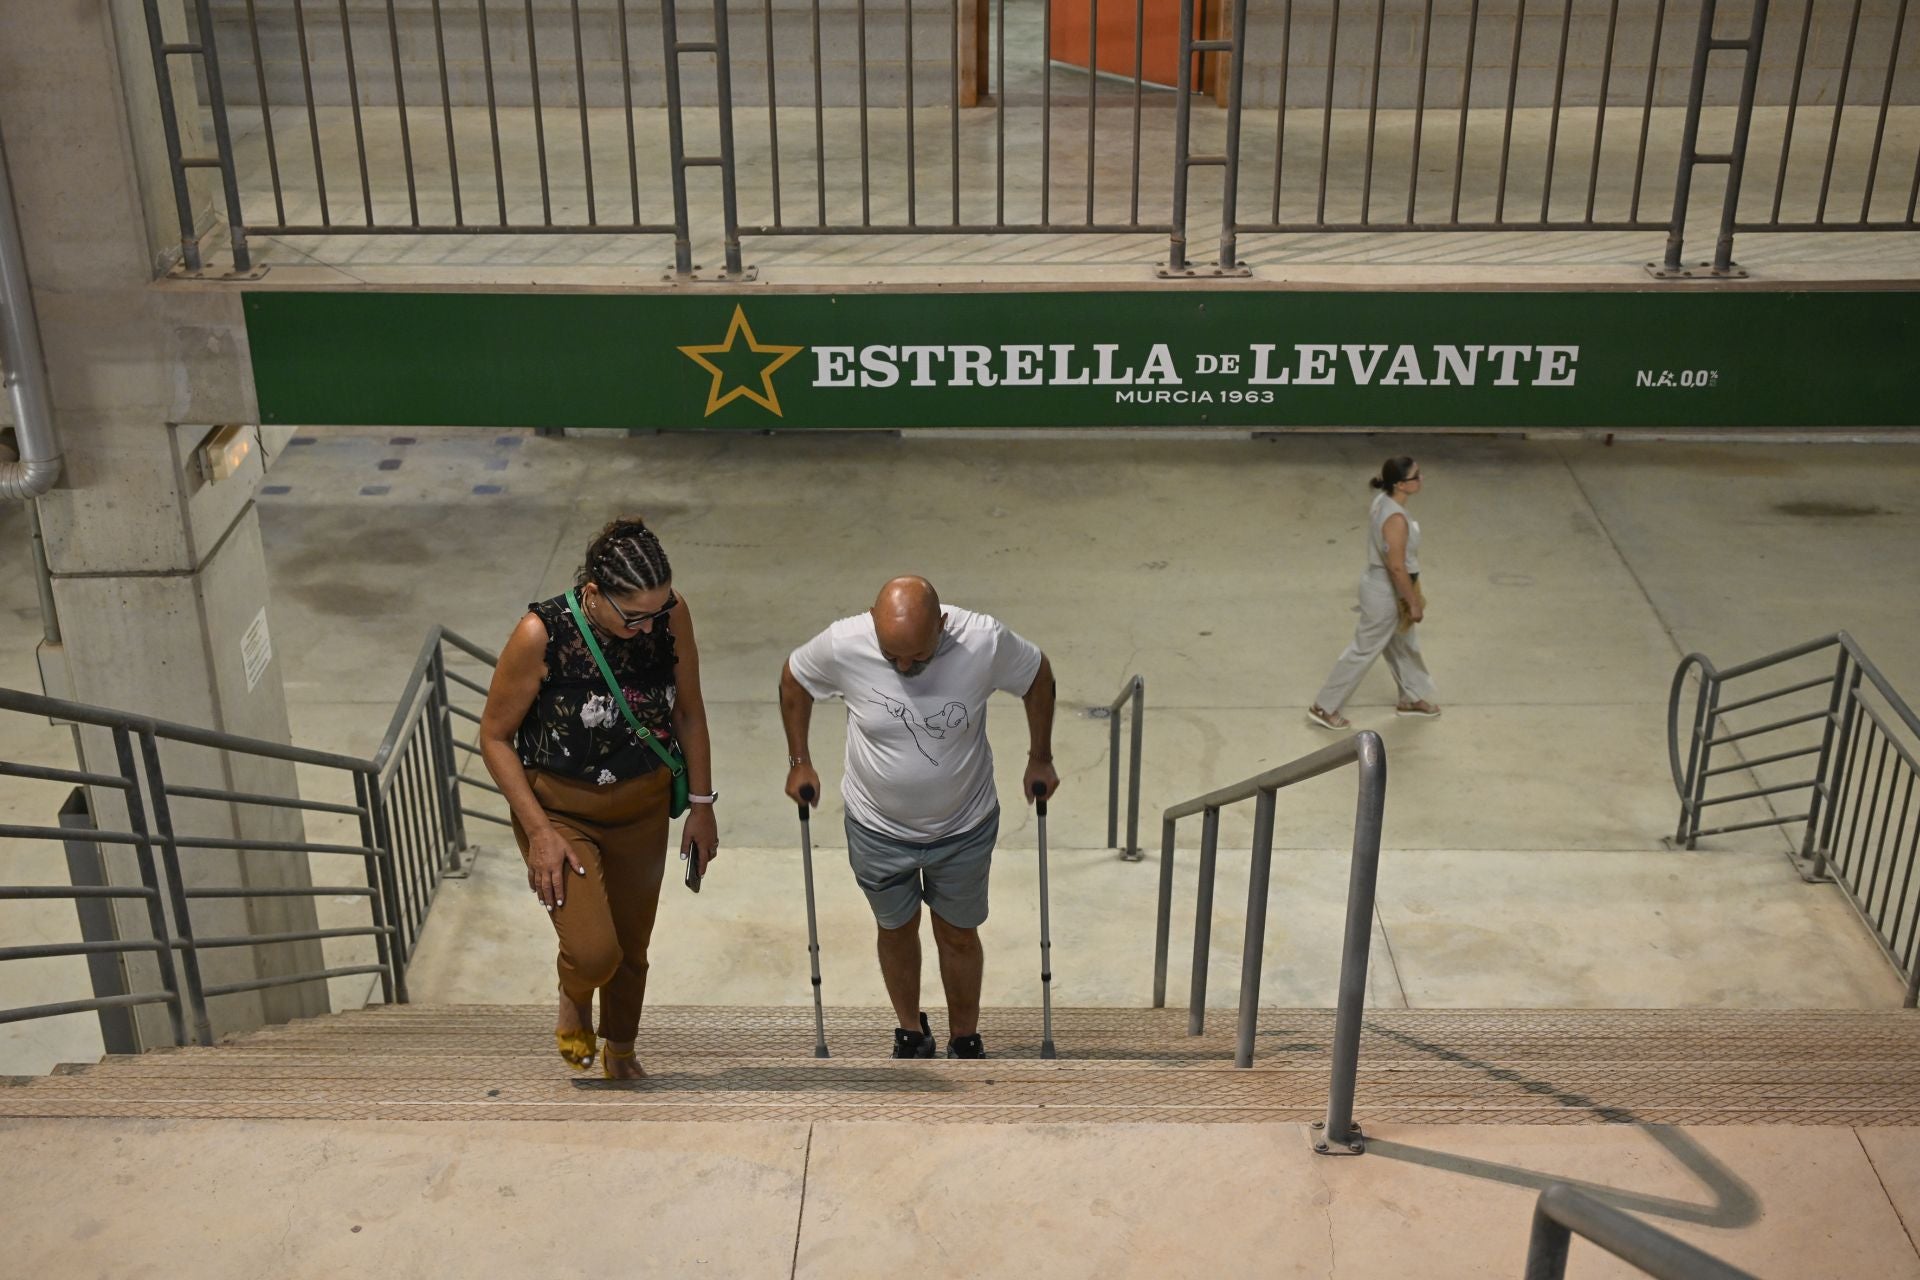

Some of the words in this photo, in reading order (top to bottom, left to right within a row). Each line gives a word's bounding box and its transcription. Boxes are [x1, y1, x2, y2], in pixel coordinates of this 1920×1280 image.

[810, 343, 1183, 388] ESTRELLA
[1194, 354, 1241, 375] DE
[1247, 343, 1580, 387] LEVANTE
[1115, 390, 1214, 404] MURCIA
[1219, 390, 1275, 404] 1963
